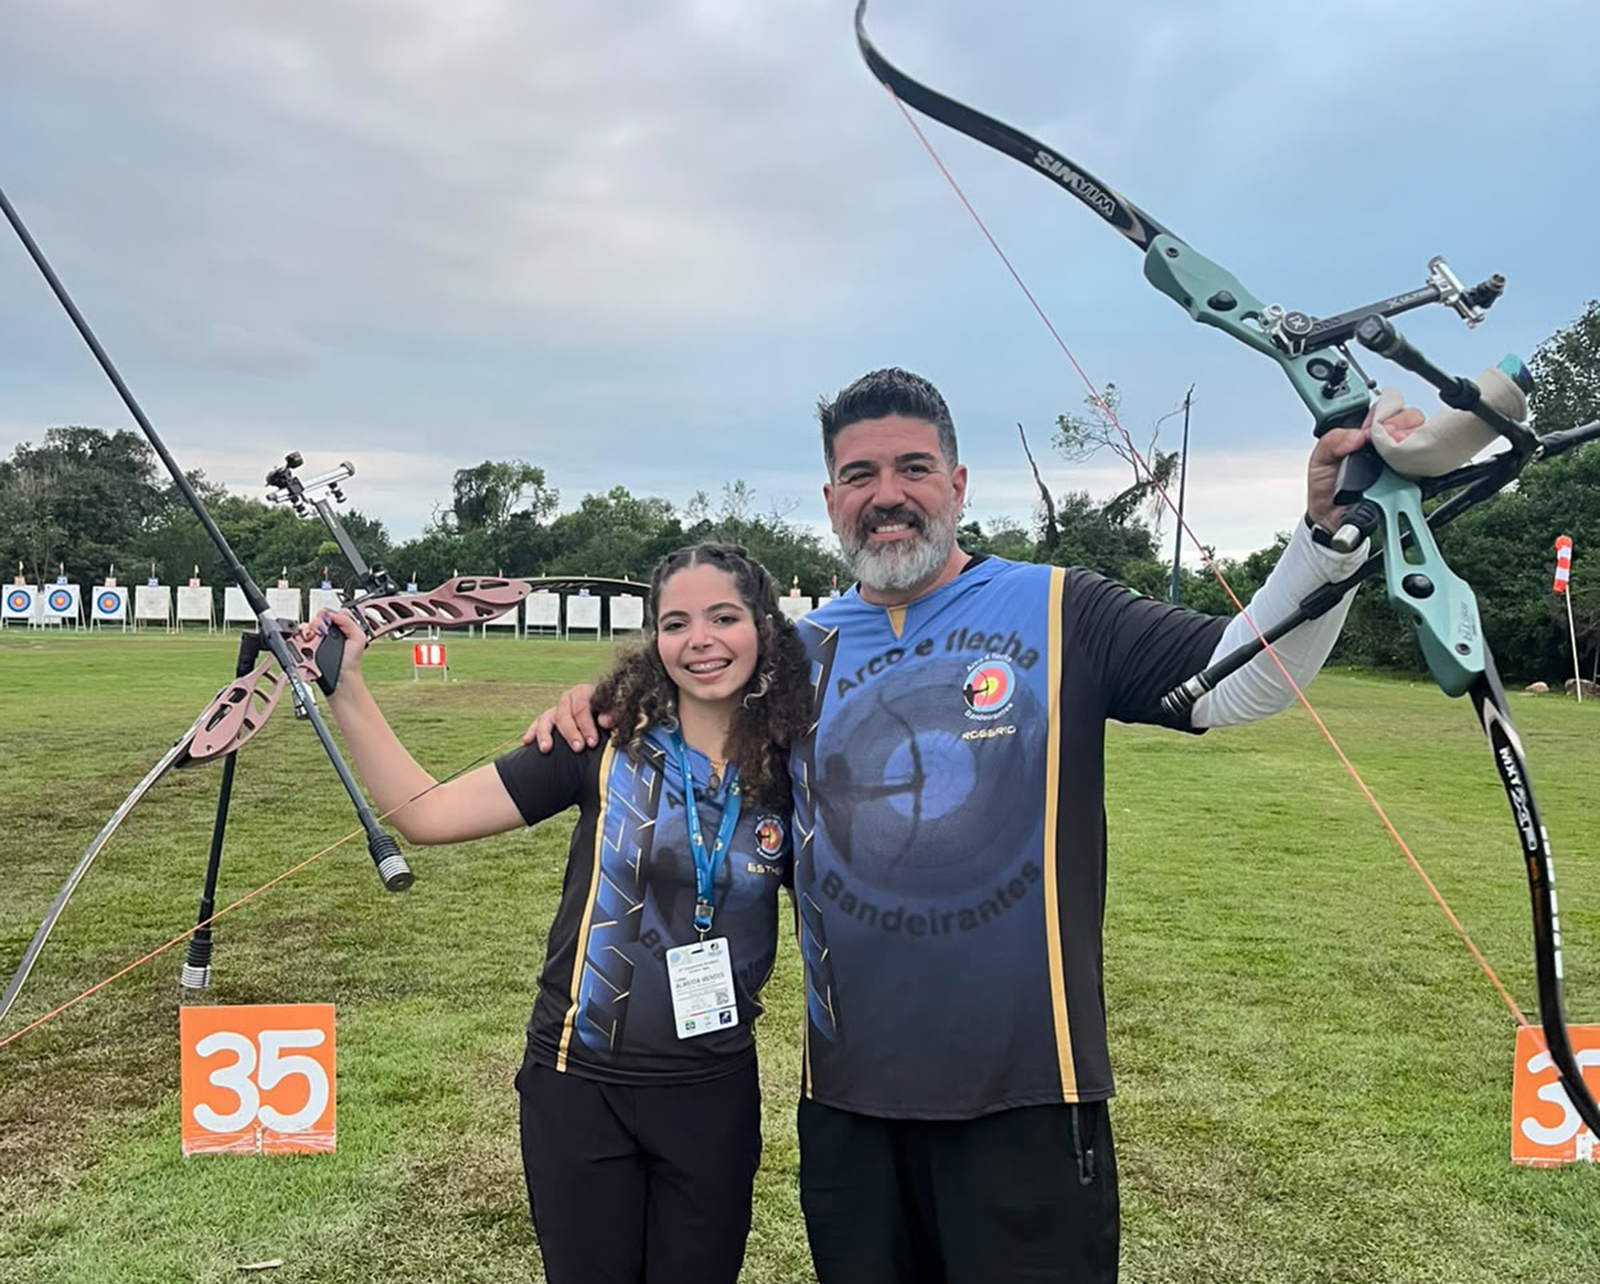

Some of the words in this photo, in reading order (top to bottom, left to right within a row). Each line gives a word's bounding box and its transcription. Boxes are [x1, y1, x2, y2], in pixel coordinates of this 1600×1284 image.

[836, 647, 906, 698] Arco
[914, 637, 934, 657] e
[820, 860, 1041, 938] Bandeirantes
[193, 1029, 329, 1133] 35
